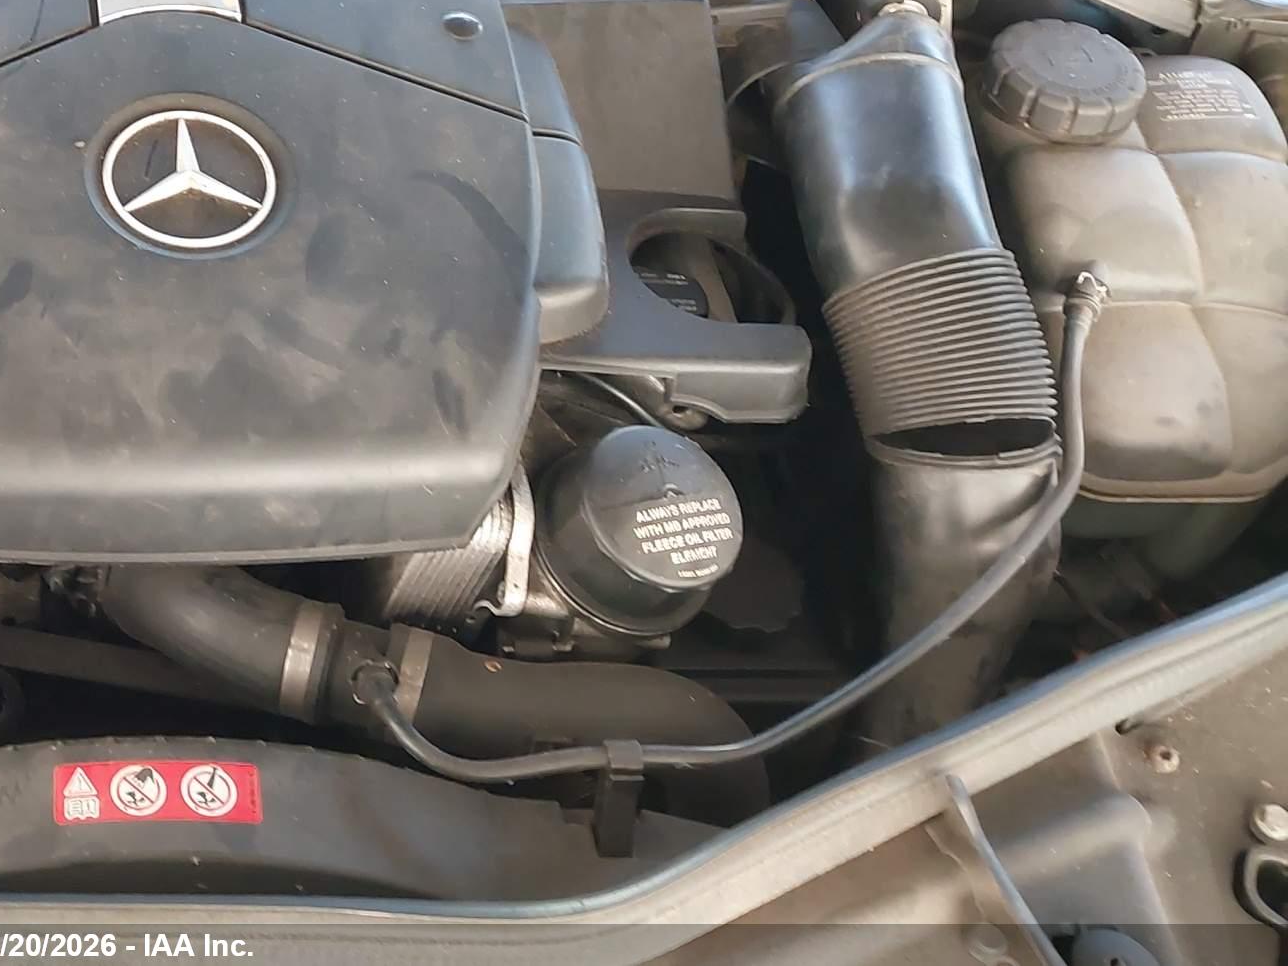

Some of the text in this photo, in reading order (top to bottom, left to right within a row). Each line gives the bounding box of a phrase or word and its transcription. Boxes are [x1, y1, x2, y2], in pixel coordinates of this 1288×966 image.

[636, 498, 722, 523] ALWAYS REPLACE
[633, 522, 665, 539] WITH
[682, 512, 731, 531] APPROVED
[641, 527, 733, 554] FLEECE OIL FILTER
[670, 545, 717, 565] ELEMENT
